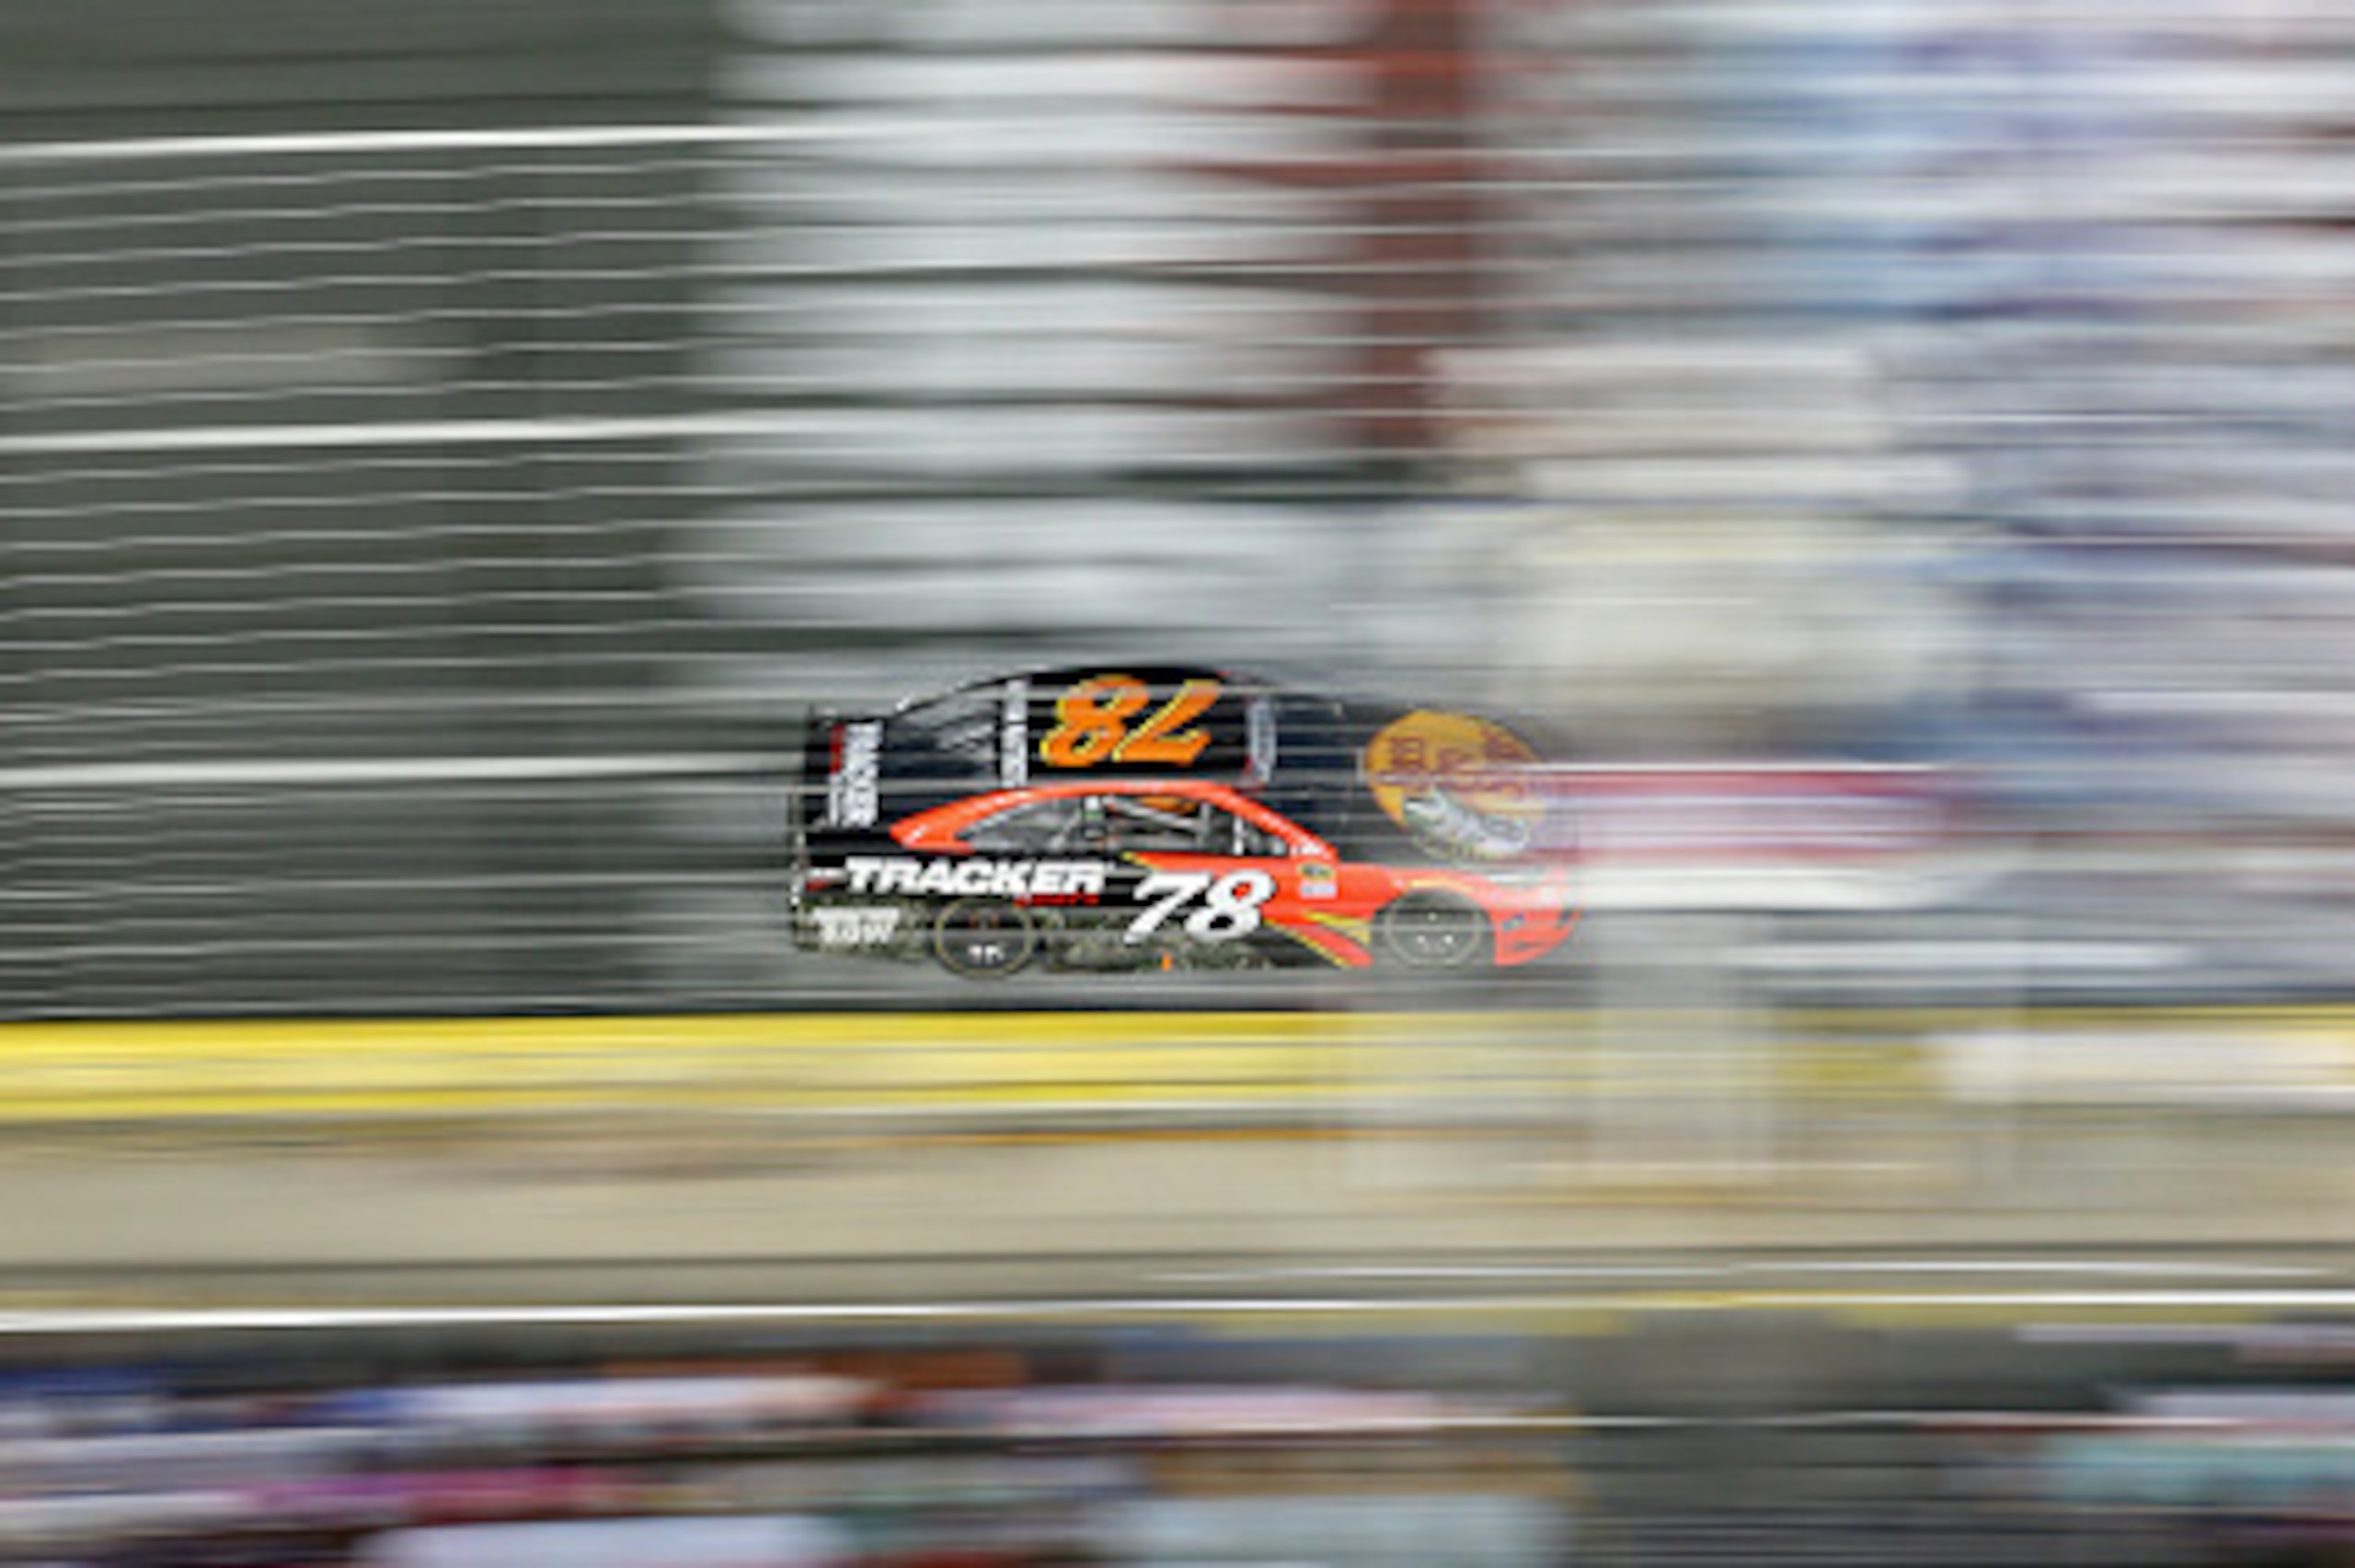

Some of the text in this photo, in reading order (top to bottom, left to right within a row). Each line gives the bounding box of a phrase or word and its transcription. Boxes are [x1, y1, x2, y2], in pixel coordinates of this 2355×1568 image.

[1040, 675, 1221, 768] 78
[846, 855, 1106, 894] TRACKER
[1123, 869, 1275, 945] 78
